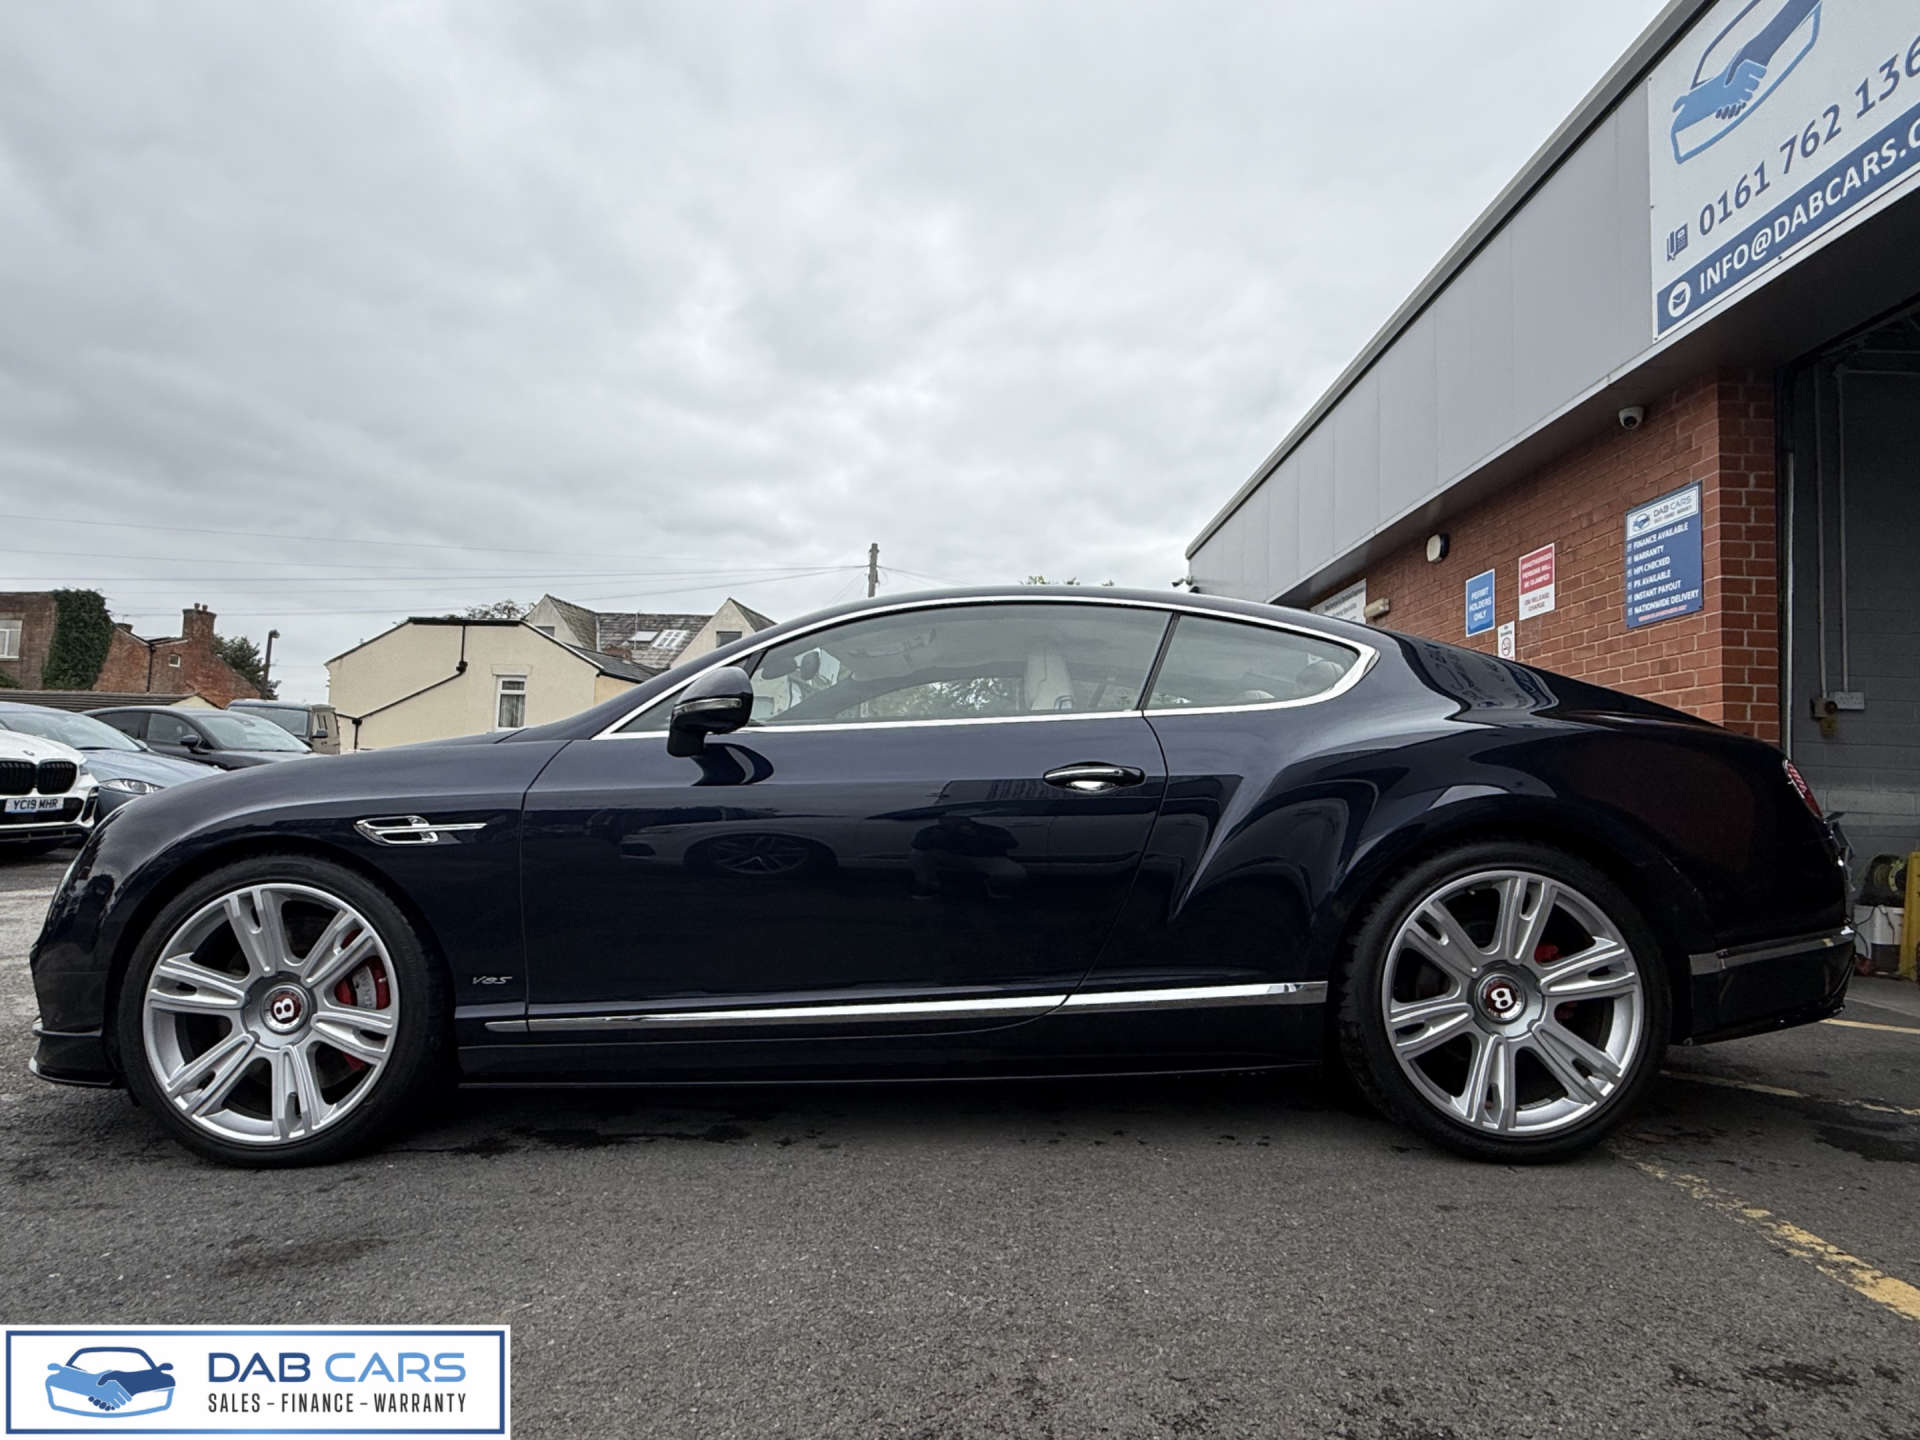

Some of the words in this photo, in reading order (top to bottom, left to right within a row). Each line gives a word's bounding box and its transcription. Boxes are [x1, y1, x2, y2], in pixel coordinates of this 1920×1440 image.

[1699, 160, 1771, 236] 0161
[1779, 103, 1842, 174] 762
[1653, 504, 1669, 517] DAB
[1670, 496, 1692, 510] CARS
[1633, 533, 1657, 550] FINANCE
[1657, 521, 1689, 541] AVAILABLE
[1633, 544, 1664, 562] WARRANTY
[1644, 556, 1671, 572] CHECKED
[1642, 569, 1671, 585] AVAILABLE
[1633, 586, 1657, 601] INSTANT
[1657, 579, 1681, 595] PAYOUT
[1469, 595, 1492, 611] HOLDERS
[1633, 596, 1670, 614] NATIONWIDE
[1670, 588, 1699, 604] DELIVERY
